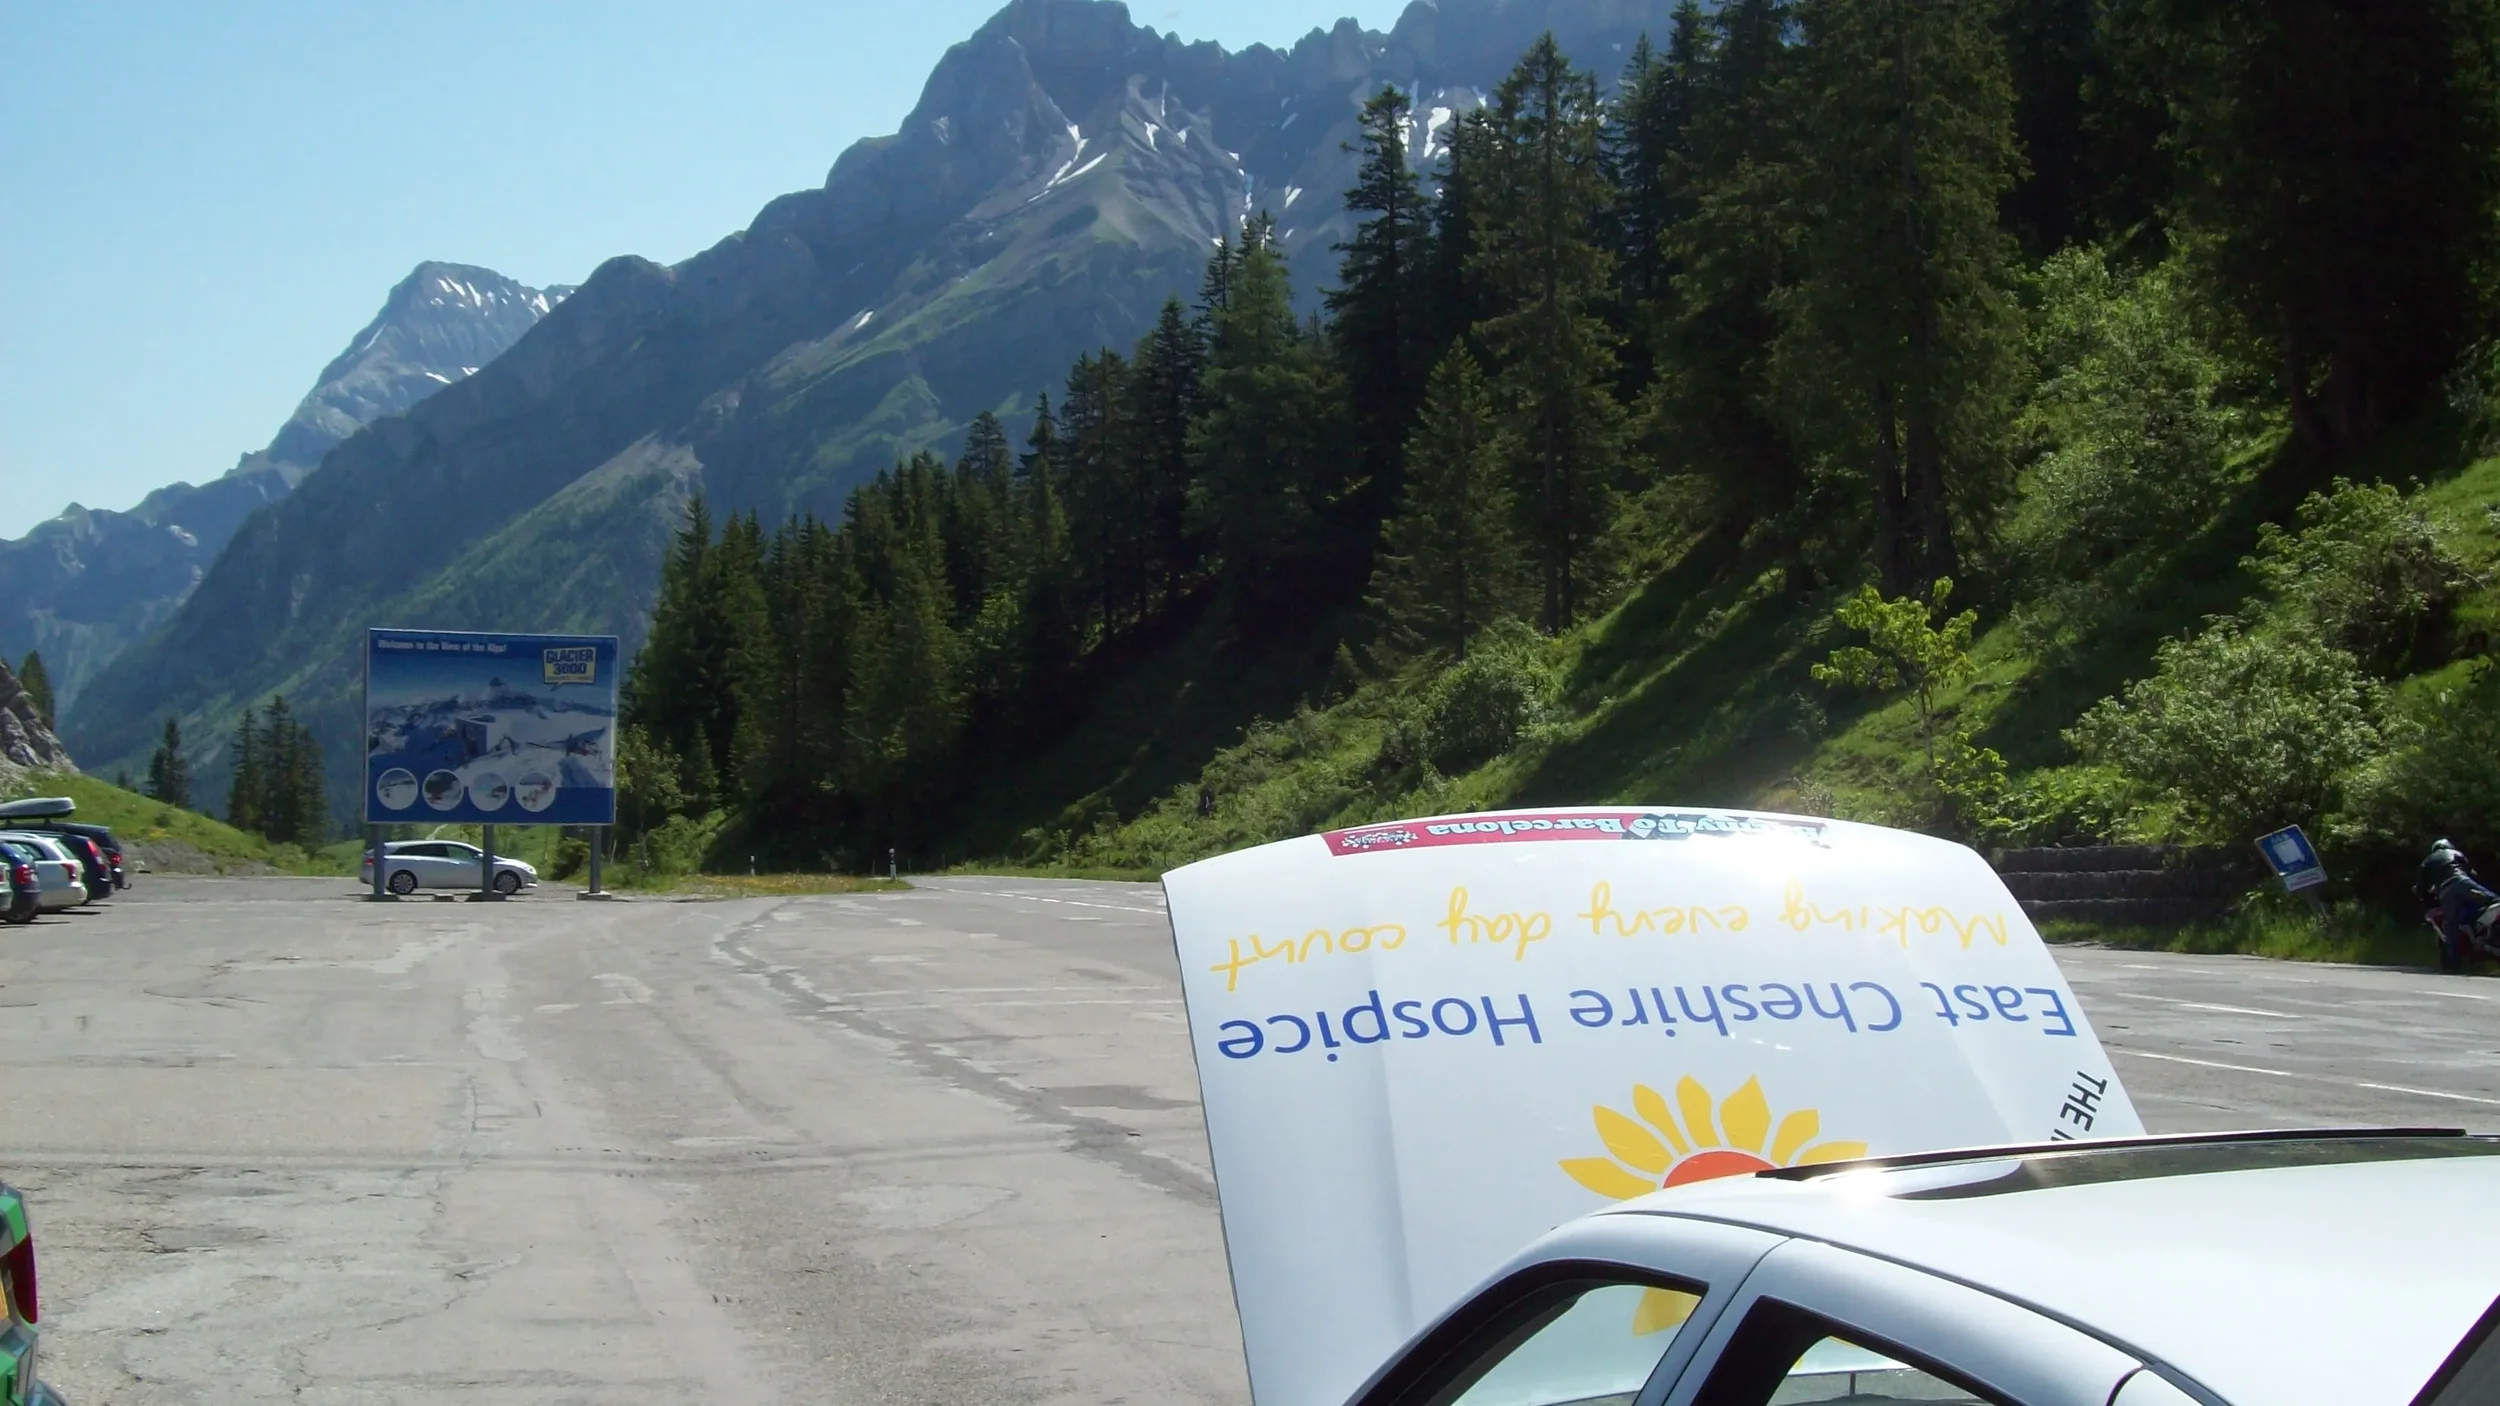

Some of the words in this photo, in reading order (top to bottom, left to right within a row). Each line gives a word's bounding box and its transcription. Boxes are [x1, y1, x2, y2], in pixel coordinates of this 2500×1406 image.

[546, 650, 594, 663] GLACIER
[552, 662, 587, 676] 3000
[1426, 816, 1627, 836] Barcelona
[1631, 815, 1689, 836] To
[1436, 886, 1551, 961] day
[1577, 880, 1749, 937] every
[1778, 878, 2008, 951] Making
[1209, 924, 1406, 992] count
[1217, 989, 1543, 1062] Hospice
[1568, 980, 1903, 1037] Cheshire
[1920, 981, 2077, 1038] East
[2059, 1070, 2108, 1132] THE
